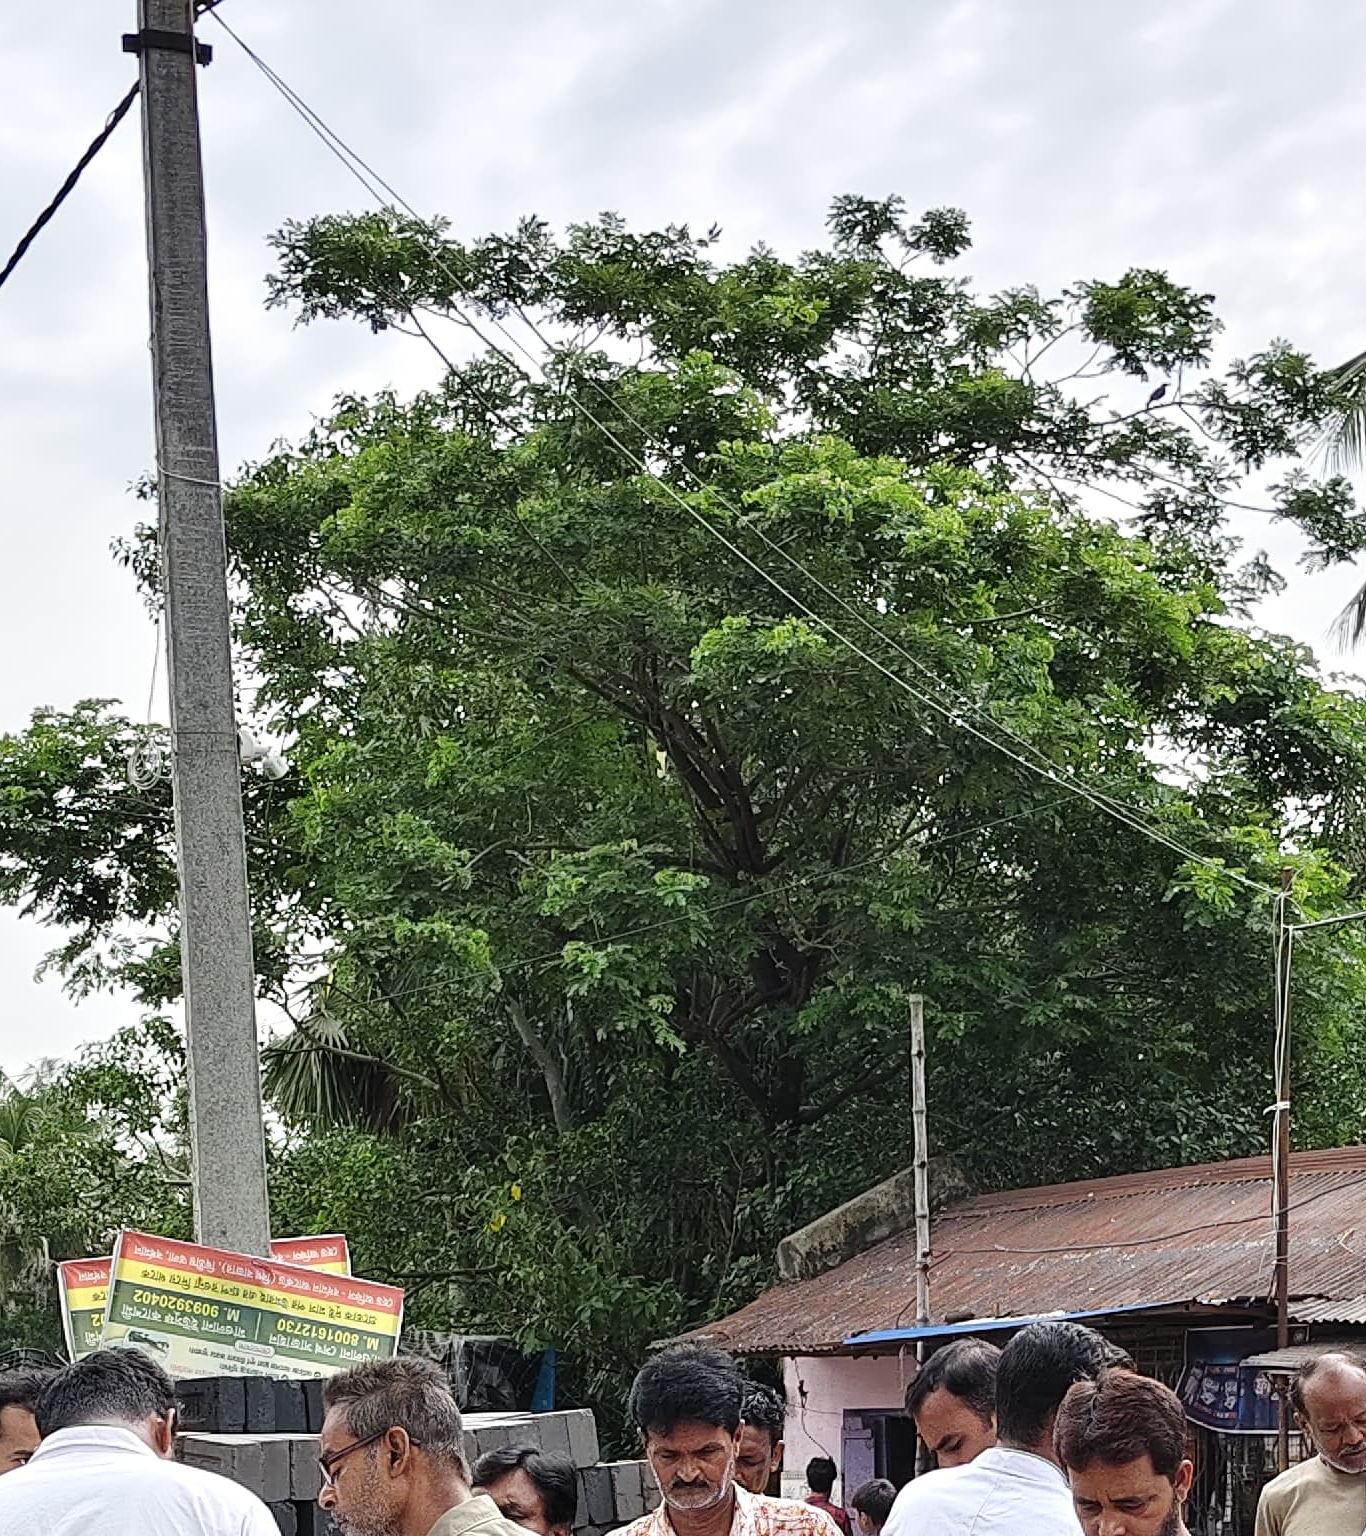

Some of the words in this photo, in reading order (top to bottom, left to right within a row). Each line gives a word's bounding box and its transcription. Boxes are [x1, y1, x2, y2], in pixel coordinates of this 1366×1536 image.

[132, 1288, 220, 1319] 9093920402
[222, 1306, 241, 1322] M.
[276, 1318, 359, 1347] 8001612730
[361, 1336, 380, 1351] M.
